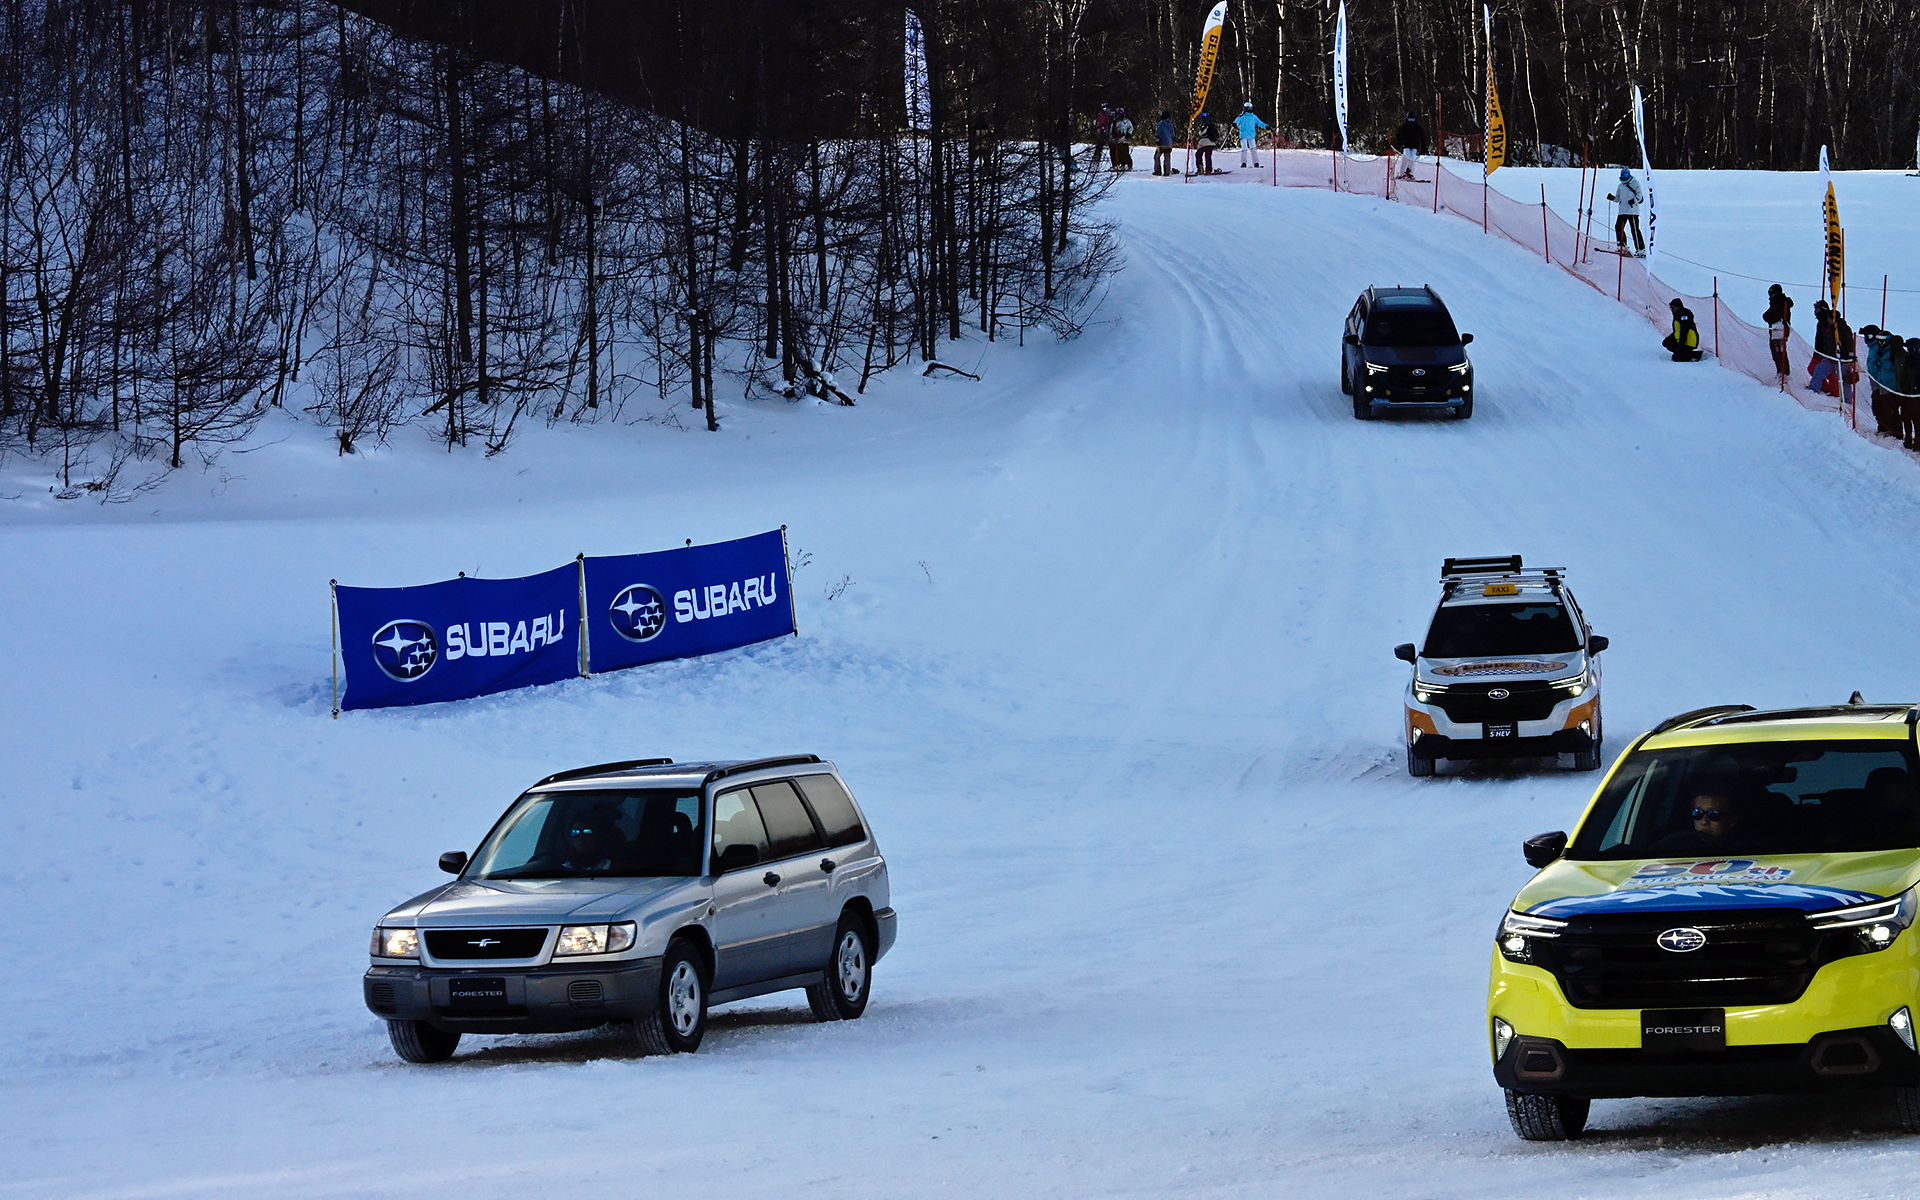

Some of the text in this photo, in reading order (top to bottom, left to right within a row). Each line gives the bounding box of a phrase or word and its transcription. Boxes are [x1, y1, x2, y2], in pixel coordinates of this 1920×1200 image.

[674, 572, 777, 623] SUBARU
[1491, 586, 1510, 594] TAXI
[445, 609, 565, 661] SUBARU
[1631, 859, 1792, 879] 50th
[1624, 875, 1724, 886] SUBARU
[1645, 1025, 1721, 1035] FORESTER
